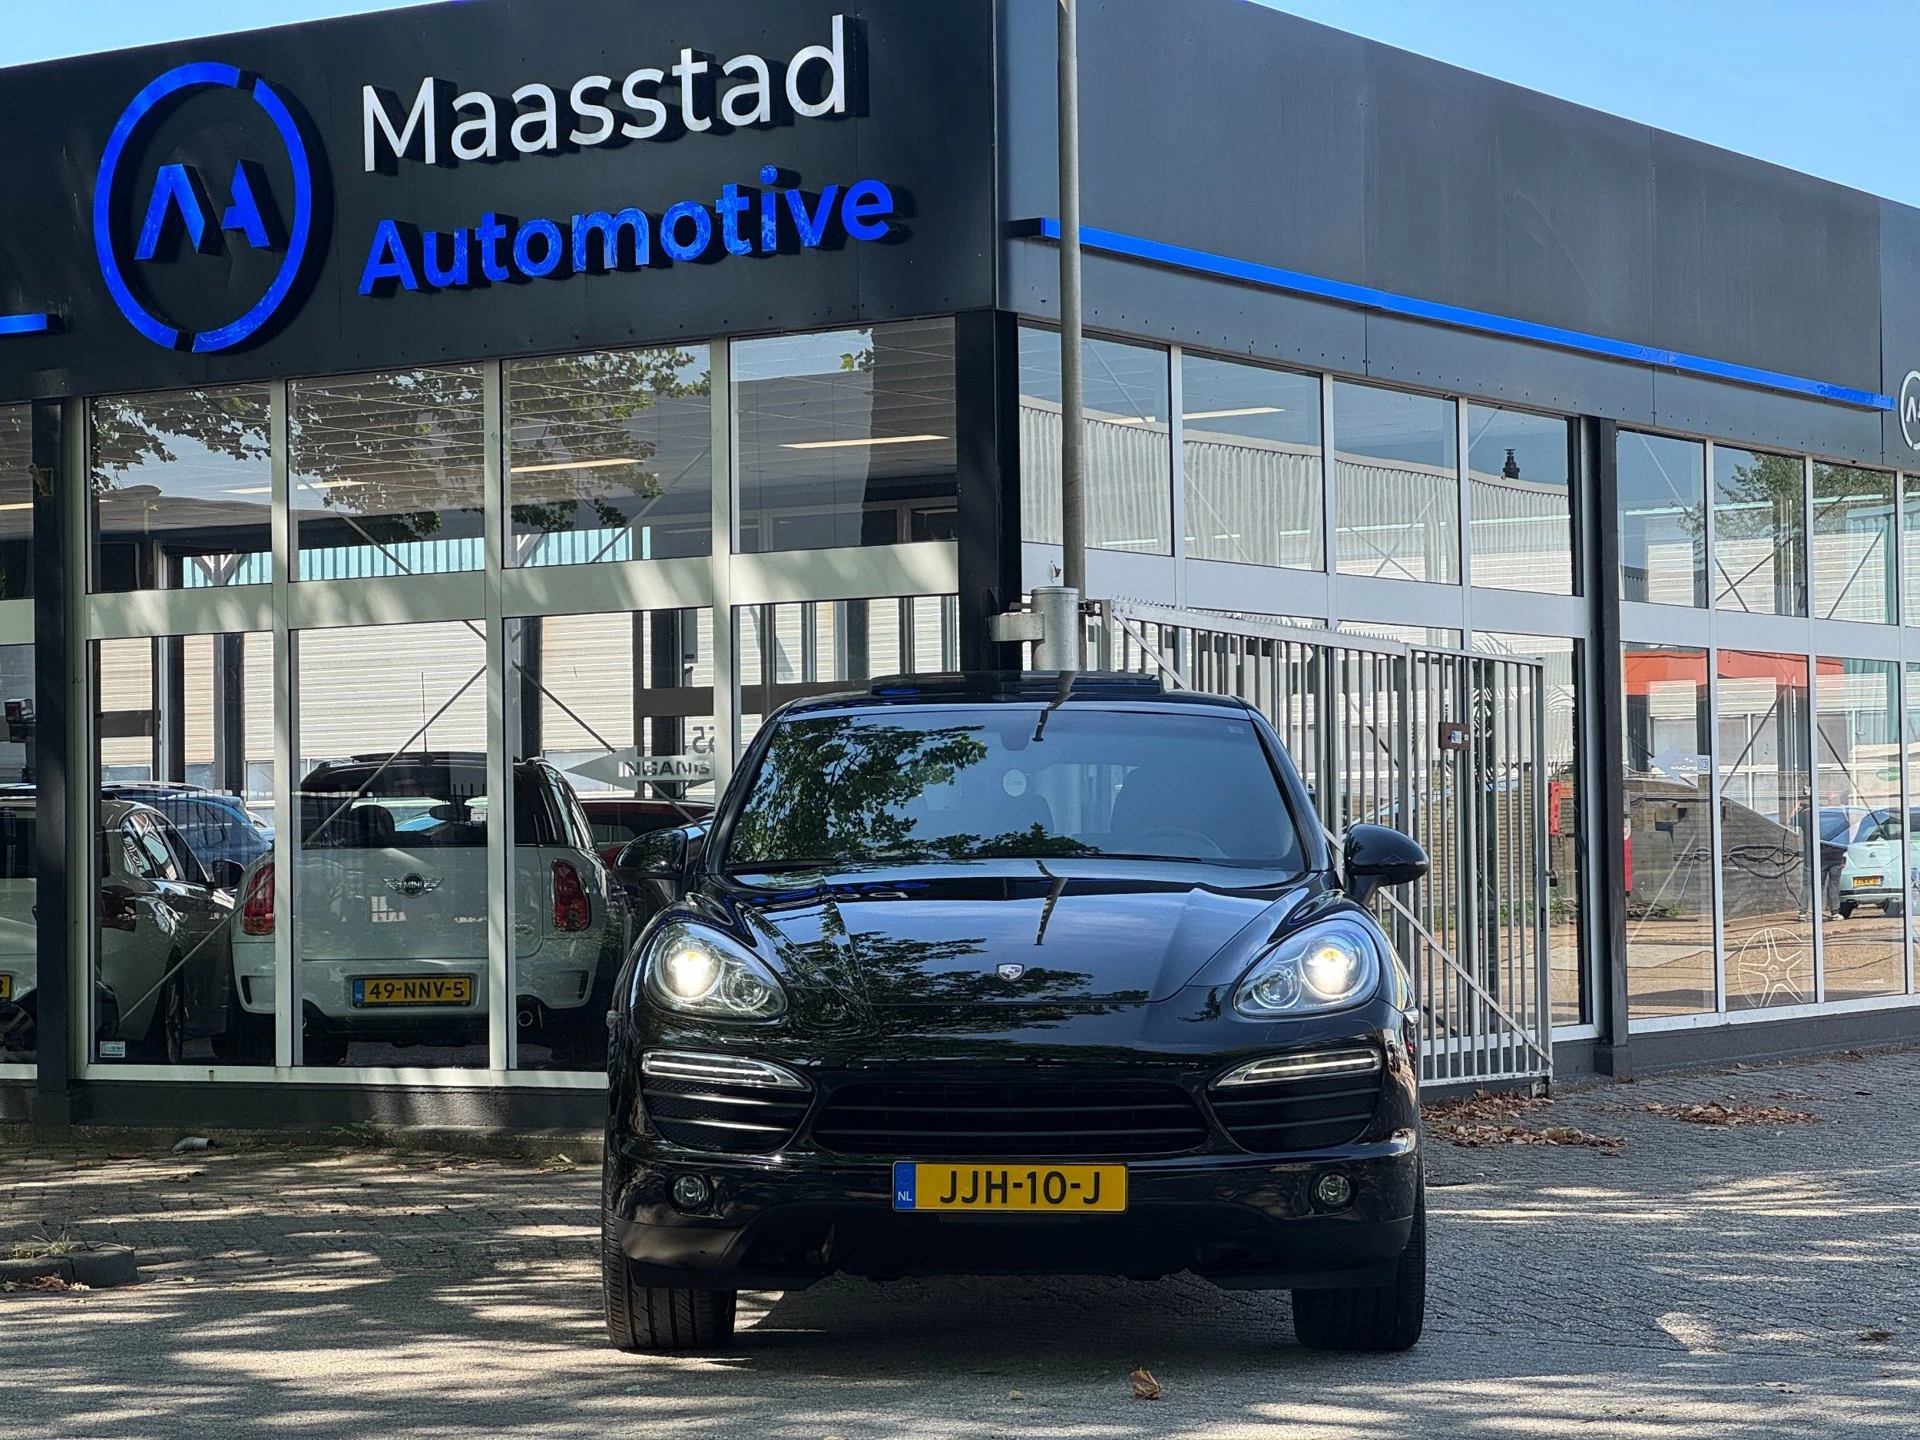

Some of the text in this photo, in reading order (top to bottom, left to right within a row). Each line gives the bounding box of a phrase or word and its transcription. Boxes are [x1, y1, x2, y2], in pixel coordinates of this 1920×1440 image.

[362, 14, 845, 172] Maasstad
[358, 164, 894, 295] Automotive
[403, 880, 423, 889] MINI
[369, 981, 464, 999] 49-NNV-5
[897, 1170, 1100, 1205] NL JJH-10-J
